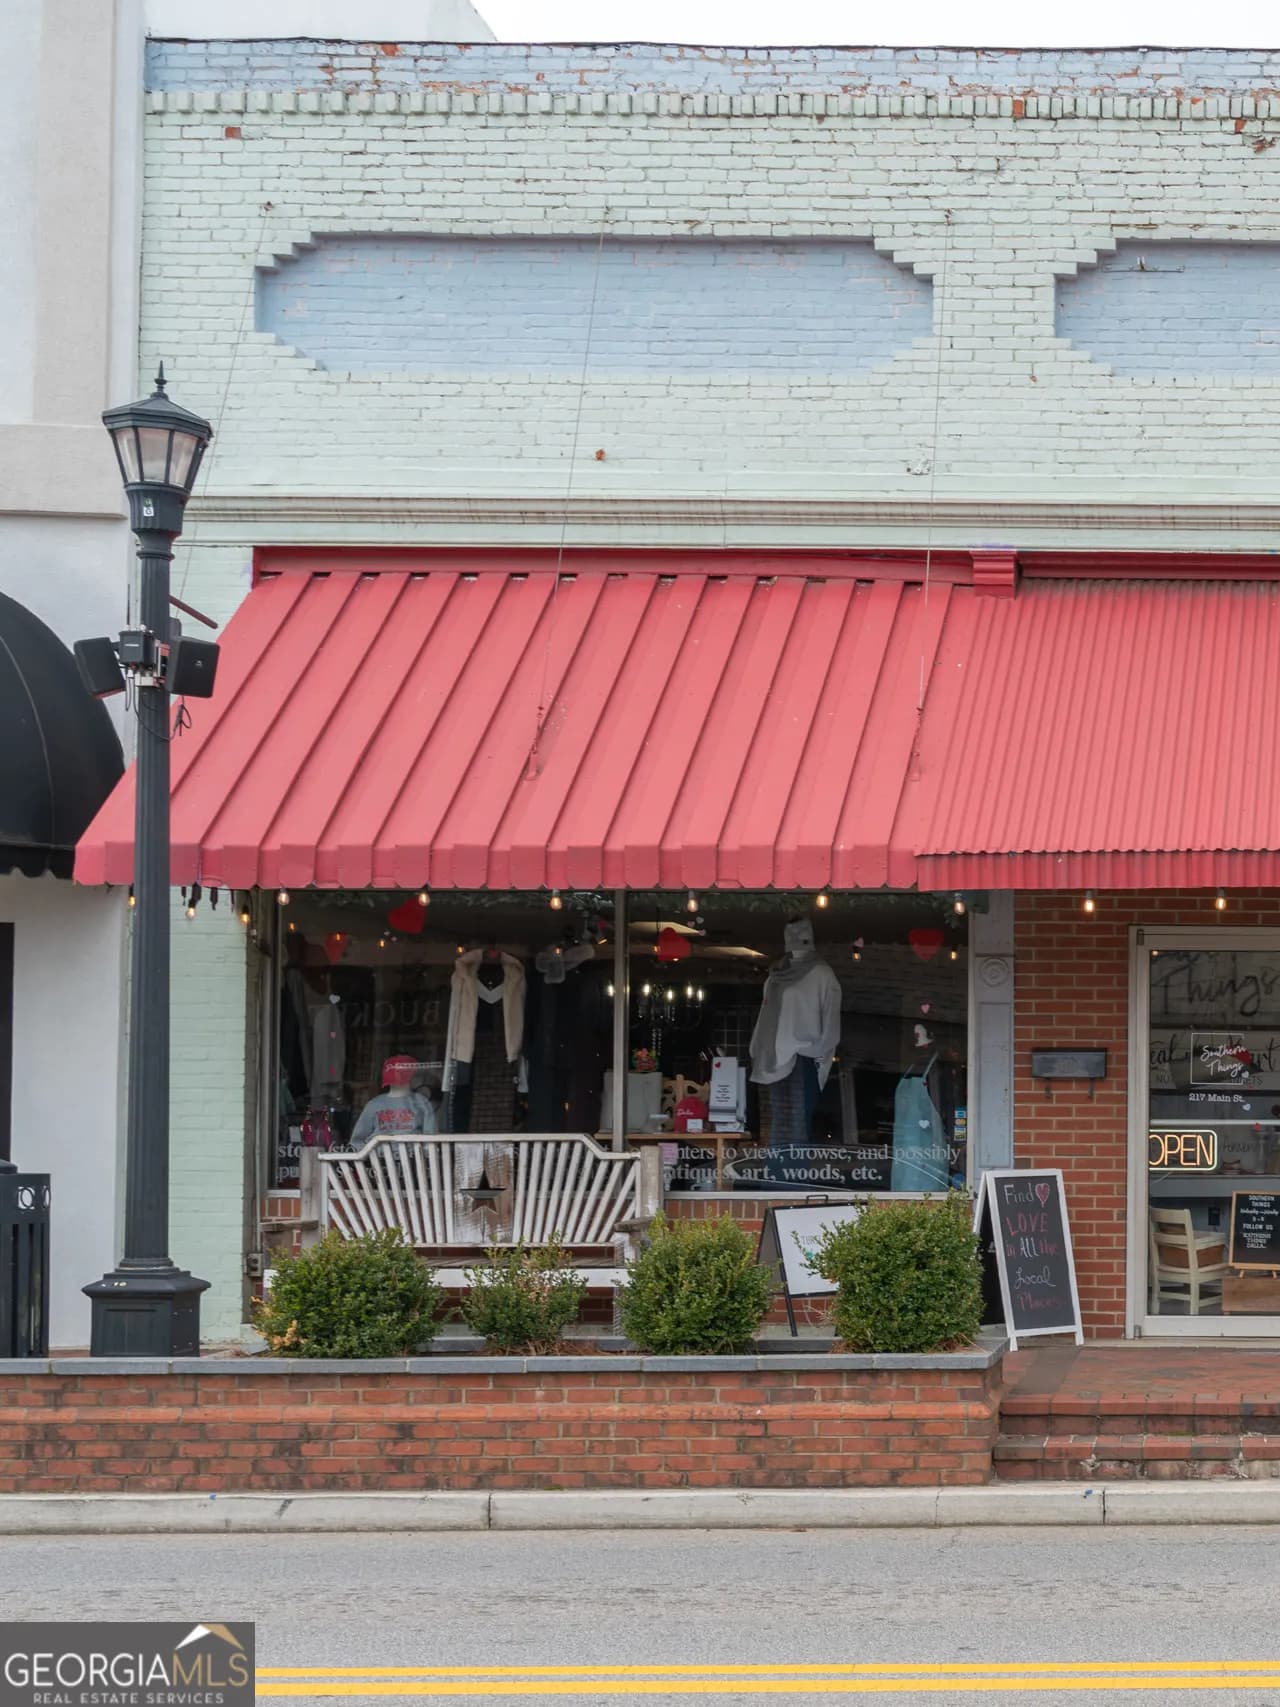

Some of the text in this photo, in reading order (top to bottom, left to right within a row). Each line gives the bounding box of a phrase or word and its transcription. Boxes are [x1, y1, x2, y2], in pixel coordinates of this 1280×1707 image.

[1200, 1044, 1248, 1062] Southern
[1205, 1057, 1244, 1078] Things
[1189, 1093, 1206, 1101] 217
[1207, 1093, 1231, 1102] Main
[677, 1146, 715, 1160] nters
[720, 1147, 737, 1160] to
[741, 1143, 785, 1163] view,
[789, 1143, 852, 1163] browse,
[857, 1143, 889, 1160] and
[895, 1143, 962, 1165] possibly
[1149, 1134, 1213, 1166] OPEN
[741, 1165, 777, 1182] art,
[783, 1164, 846, 1184] woods,
[851, 1165, 883, 1181] etc.
[1003, 1182, 1035, 1206] Find
[1005, 1213, 1049, 1236] LOVE
[1014, 1265, 1057, 1290] Local
